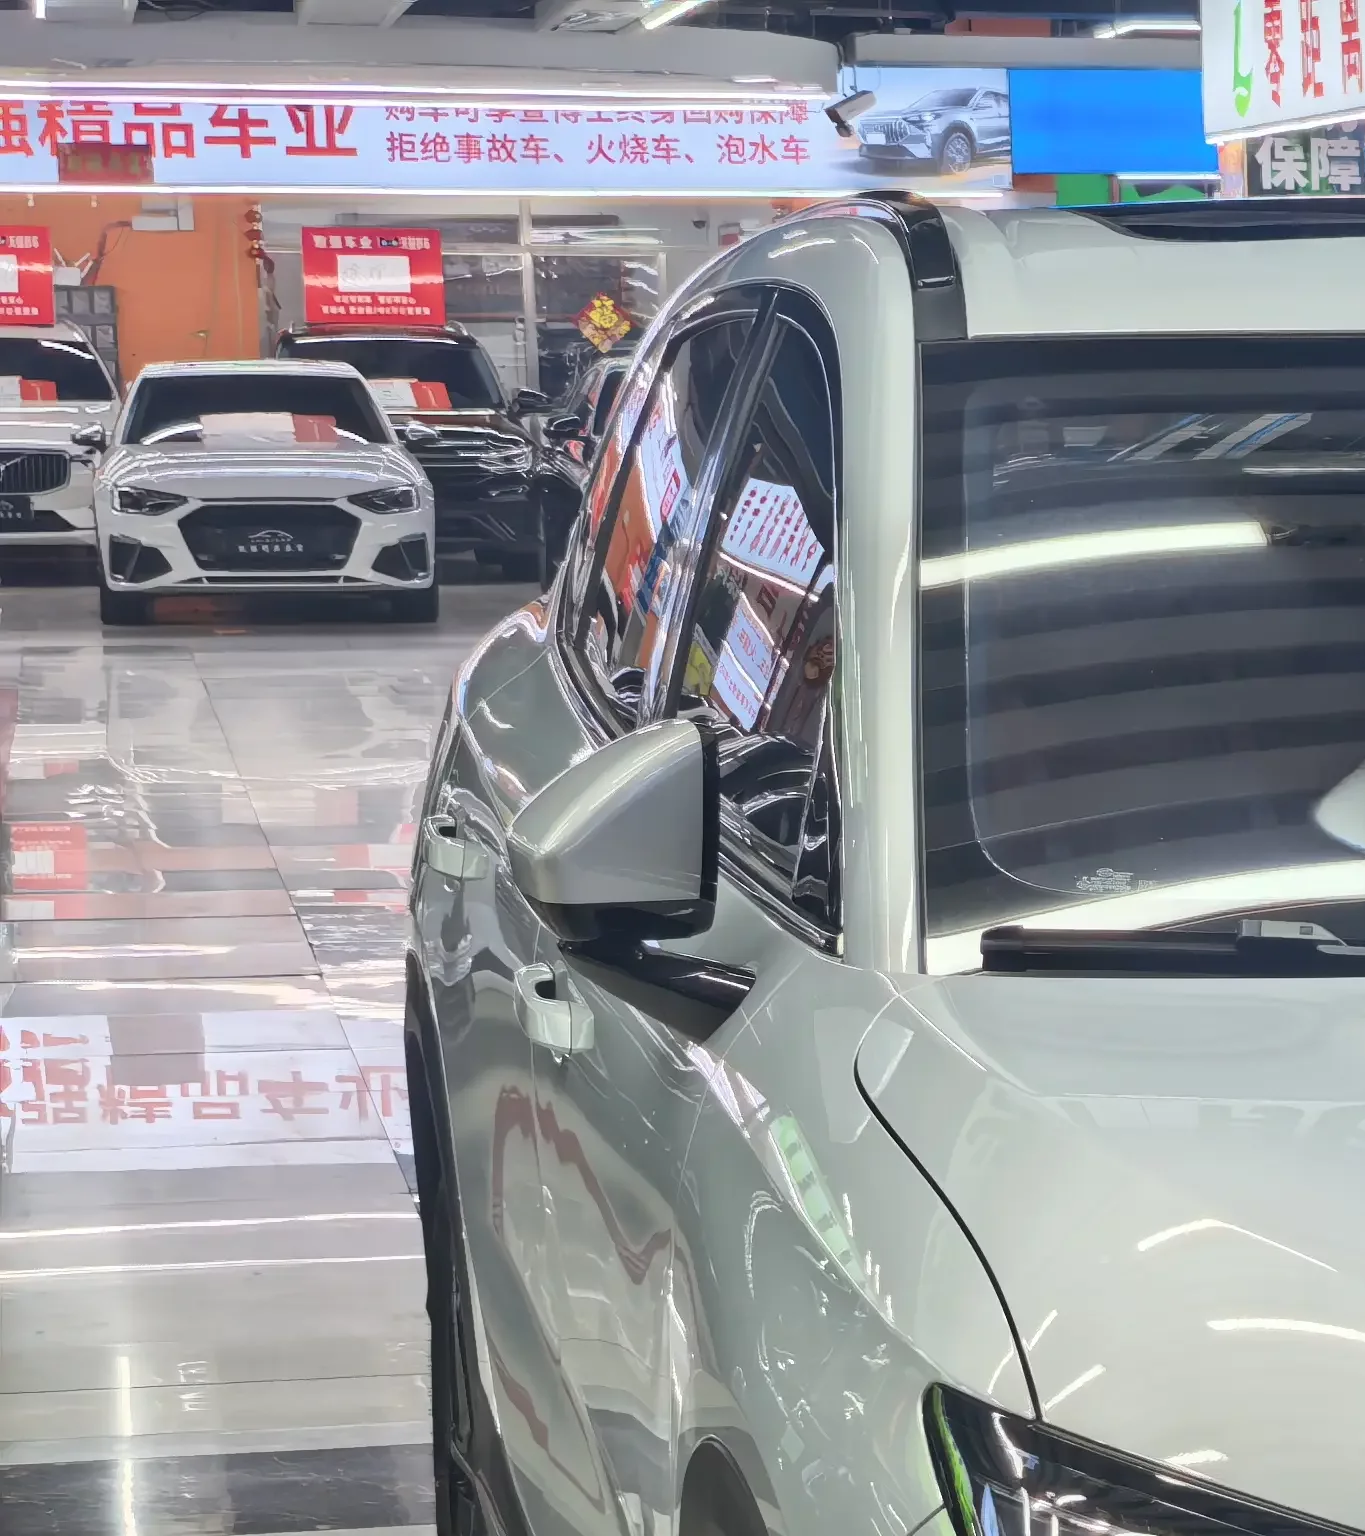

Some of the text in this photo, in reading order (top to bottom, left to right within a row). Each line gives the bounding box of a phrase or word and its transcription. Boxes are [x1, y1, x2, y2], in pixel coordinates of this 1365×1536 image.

[386, 131, 810, 165] 拒绝事故车、火烧车、泡水车
[1255, 136, 1362, 191] 保障
